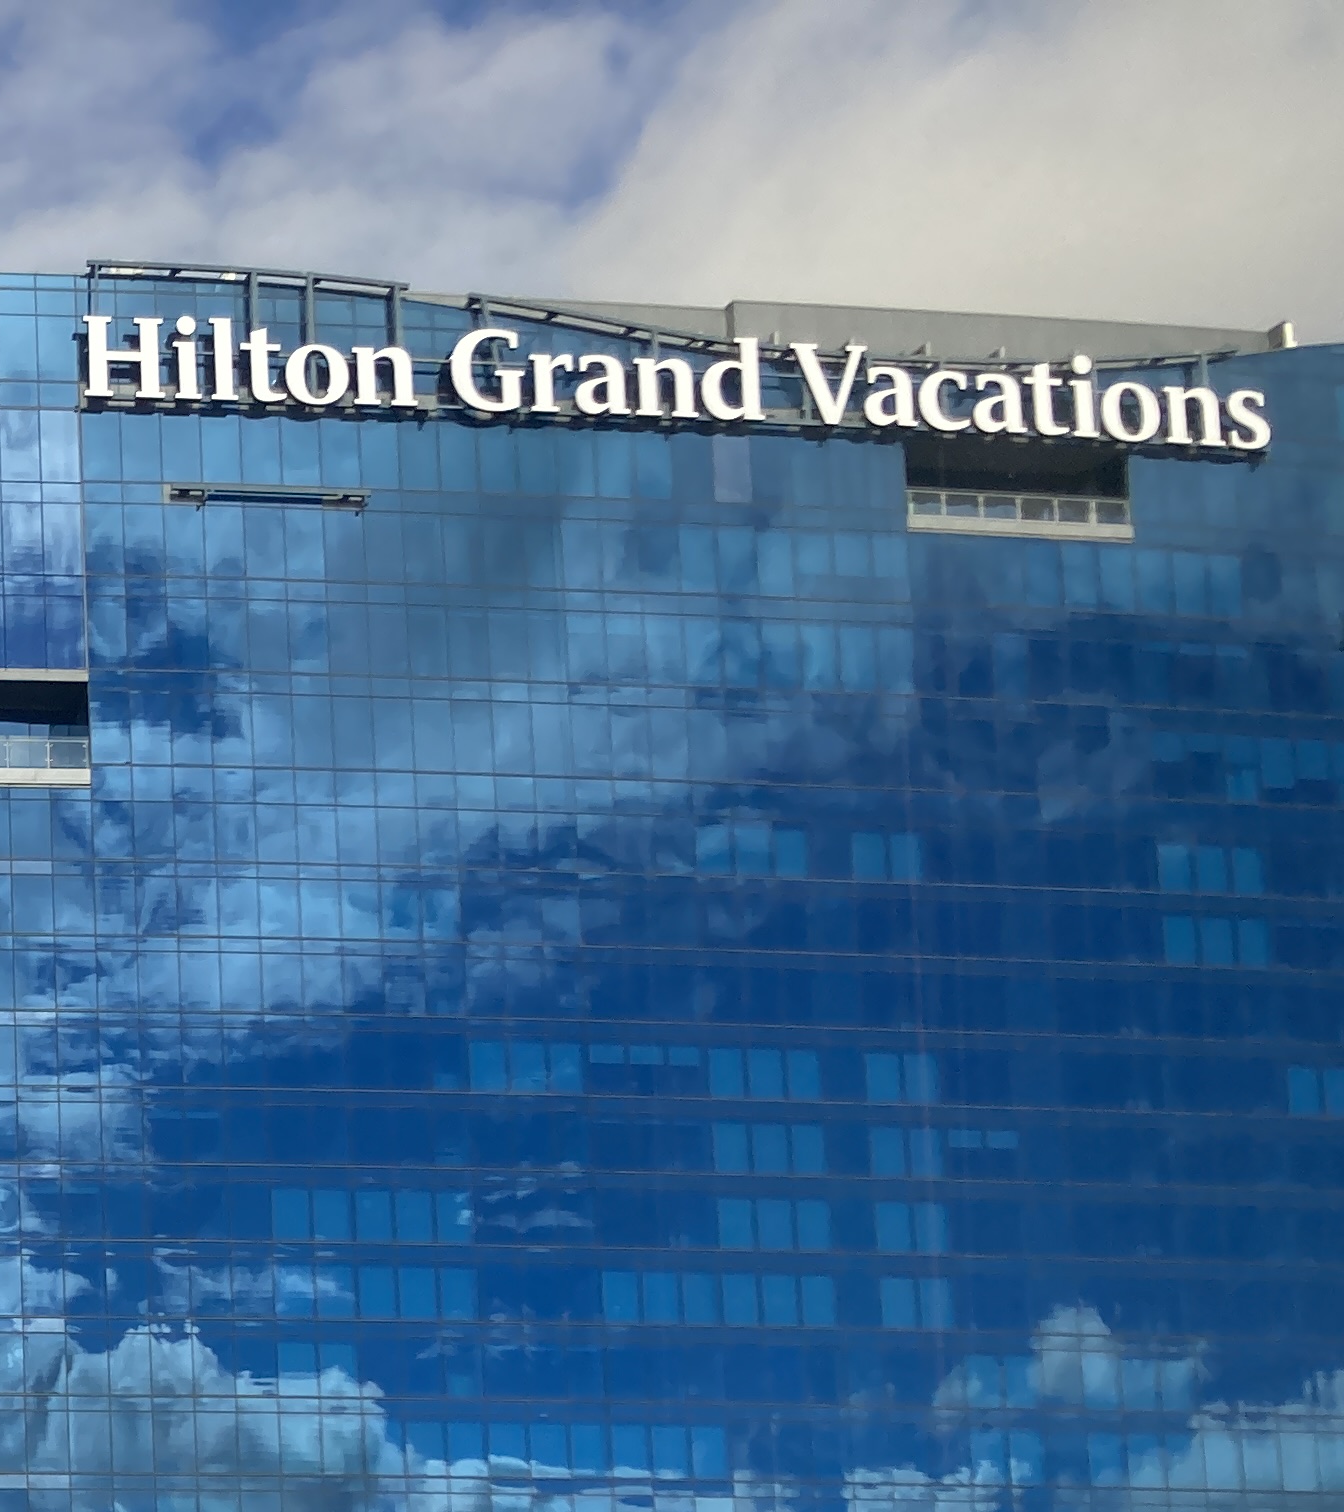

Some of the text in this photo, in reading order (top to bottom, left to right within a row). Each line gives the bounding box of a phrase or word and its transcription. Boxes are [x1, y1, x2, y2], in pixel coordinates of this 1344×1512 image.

[82, 314, 1273, 451] Hilton Grand Vacations
